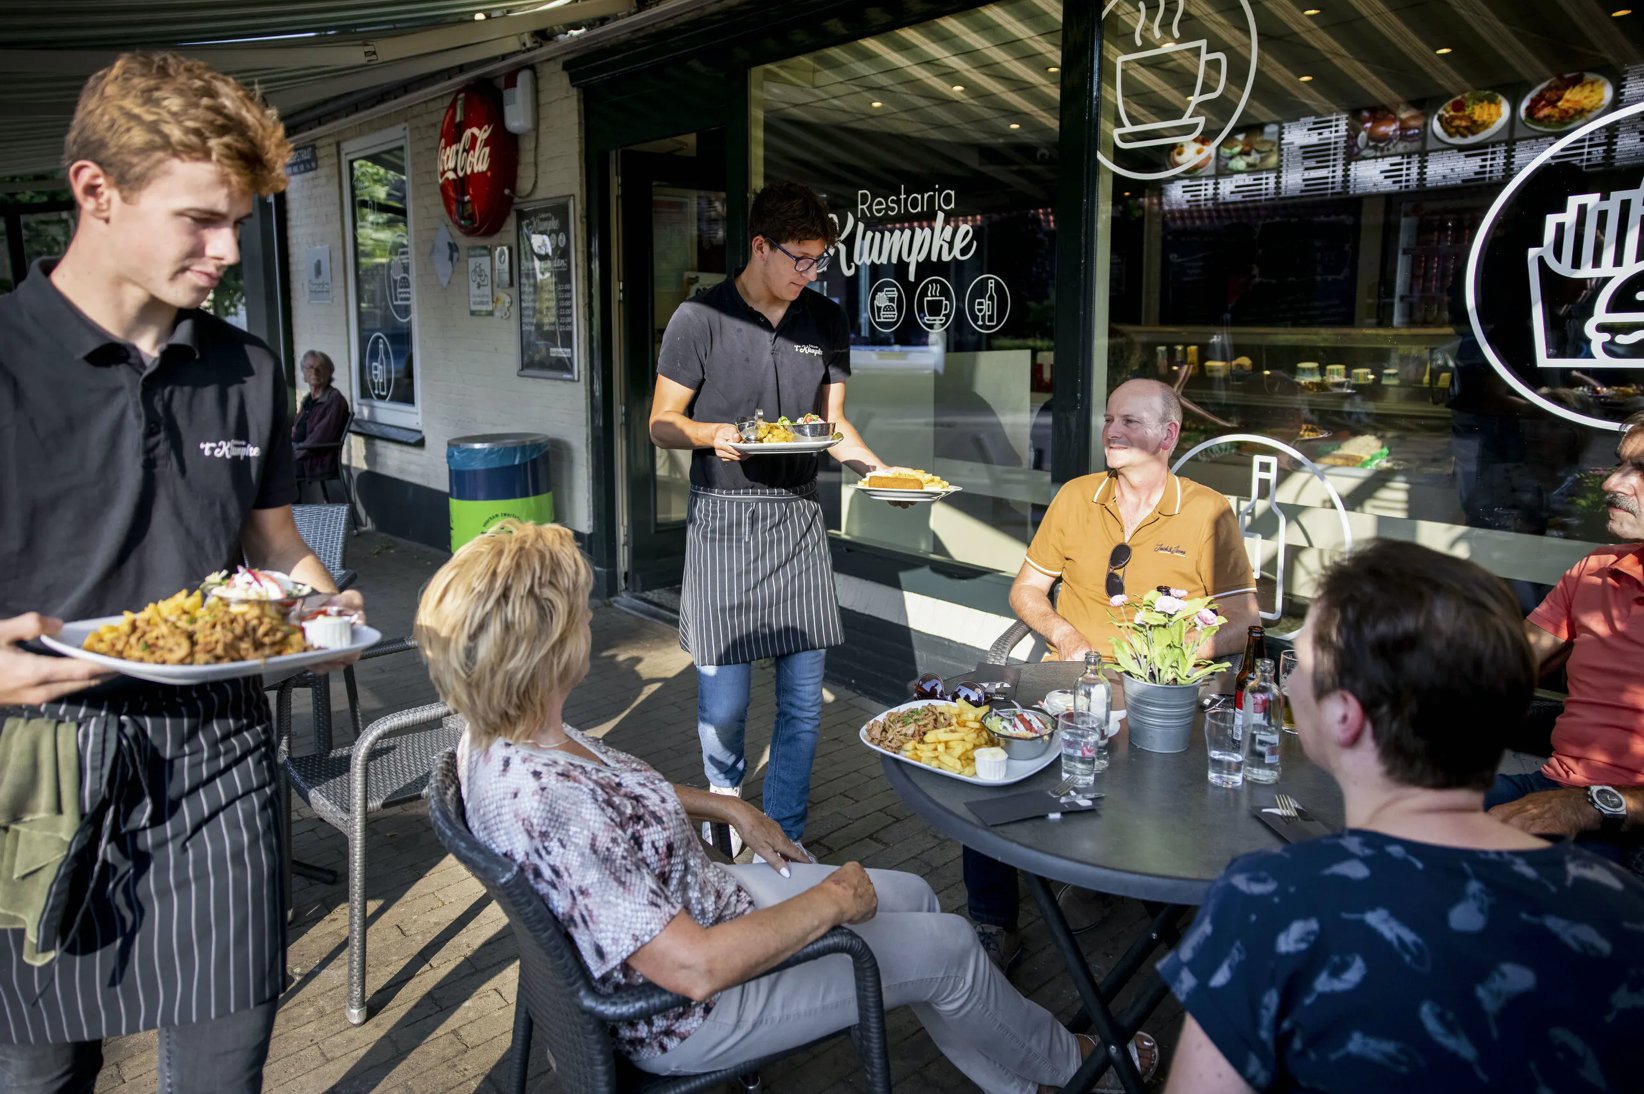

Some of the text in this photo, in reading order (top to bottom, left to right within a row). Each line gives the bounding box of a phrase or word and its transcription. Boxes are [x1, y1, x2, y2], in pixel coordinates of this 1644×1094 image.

[437, 123, 494, 184] Coca-Cola
[857, 184, 955, 218] Restaria
[818, 210, 977, 282] Klumpke
